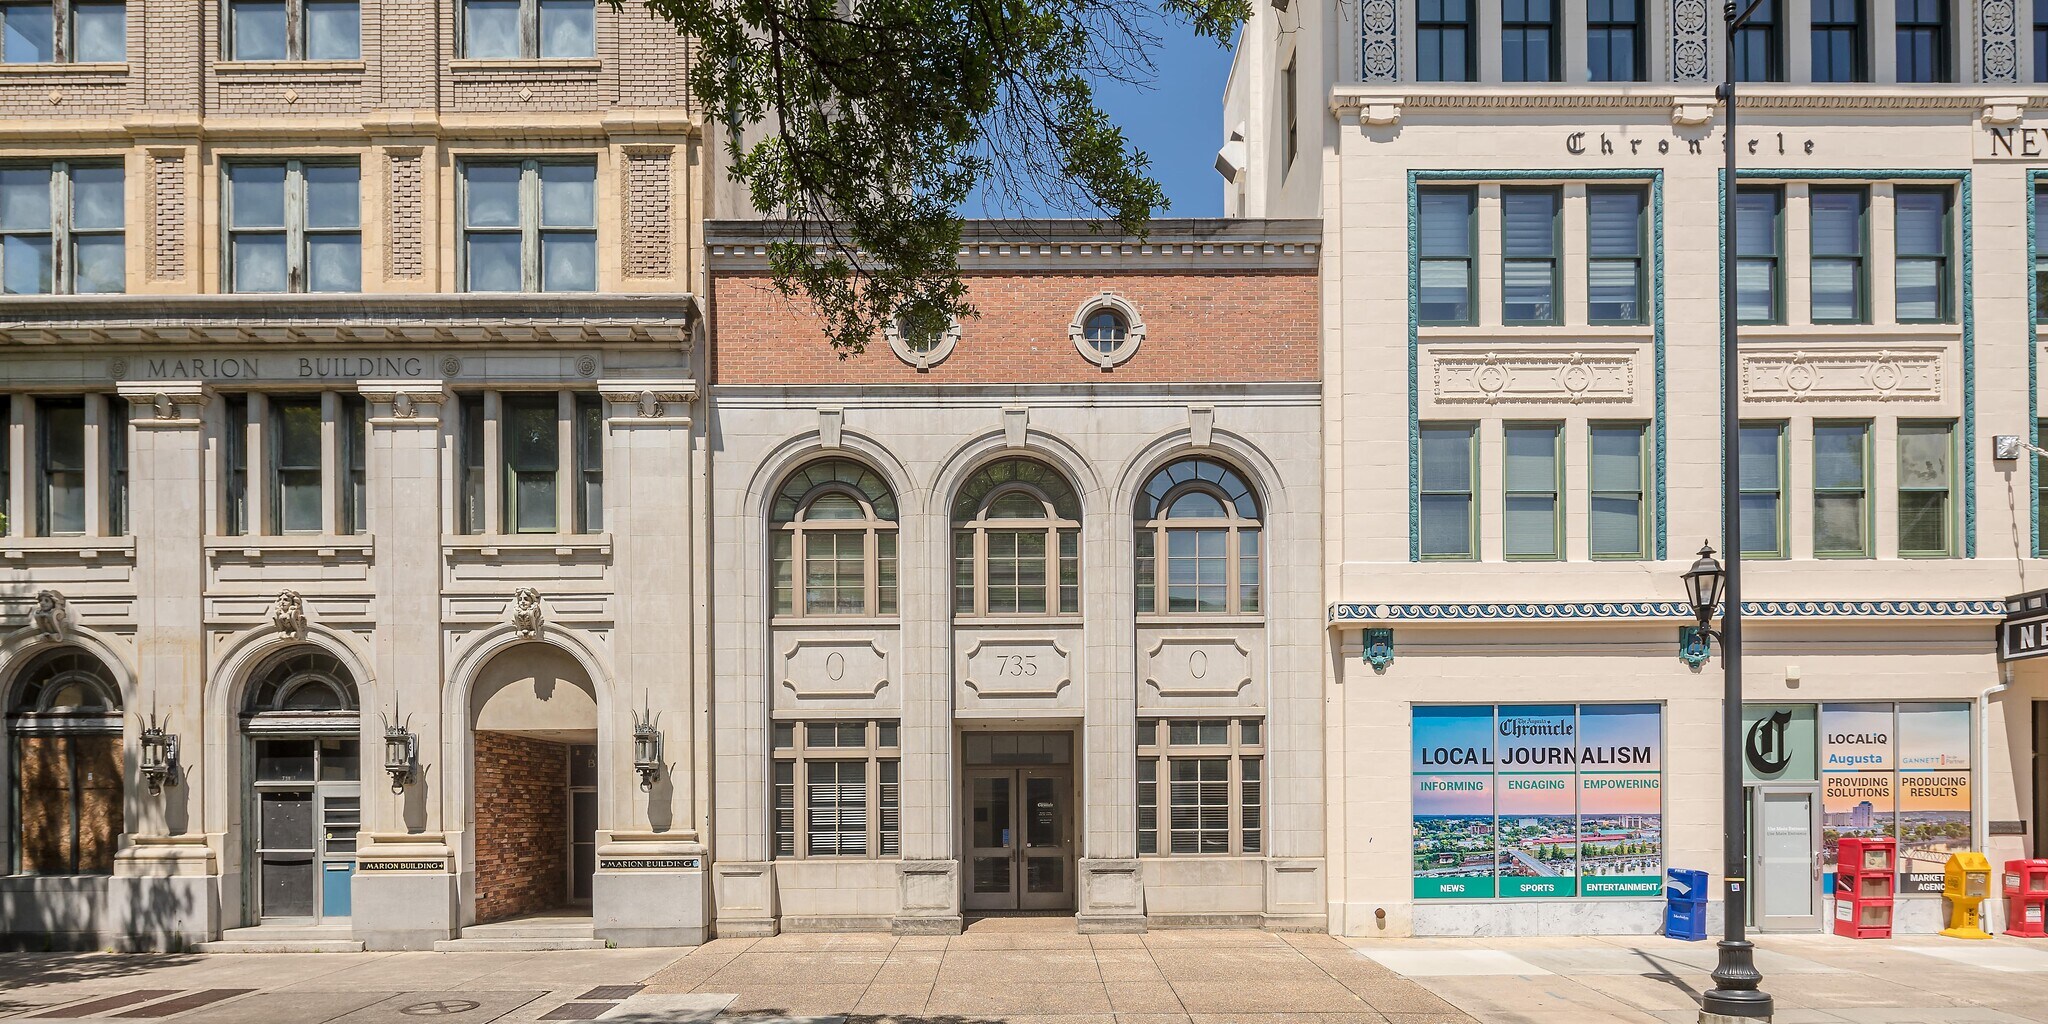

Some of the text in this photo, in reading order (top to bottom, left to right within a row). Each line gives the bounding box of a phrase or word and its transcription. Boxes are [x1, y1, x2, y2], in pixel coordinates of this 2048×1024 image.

[147, 357, 422, 378] MARION BUILDING
[996, 654, 1038, 677] 735
[1500, 718, 1573, 738] Chronicle
[1746, 709, 1794, 774] C
[1828, 733, 1887, 744] LOCALiQ
[1422, 746, 1651, 765] LOCAL JOURNALISM
[1829, 753, 1882, 766] Augusta
[1421, 781, 1484, 791] INFORMING
[1508, 780, 1565, 790] ENGAGING
[1584, 779, 1659, 789] EMPOWERING
[1828, 777, 1888, 787] PROVIDING
[1902, 777, 1966, 787] PRODUCING
[1827, 787, 1889, 797] SOLUTIONS
[1910, 787, 1958, 797] RESULTS
[646, 860, 692, 868] BUILDING
[1440, 884, 1465, 892] NEWS
[1520, 884, 1555, 892] SPORTS
[1586, 883, 1658, 892] ENTERTAINMENT
